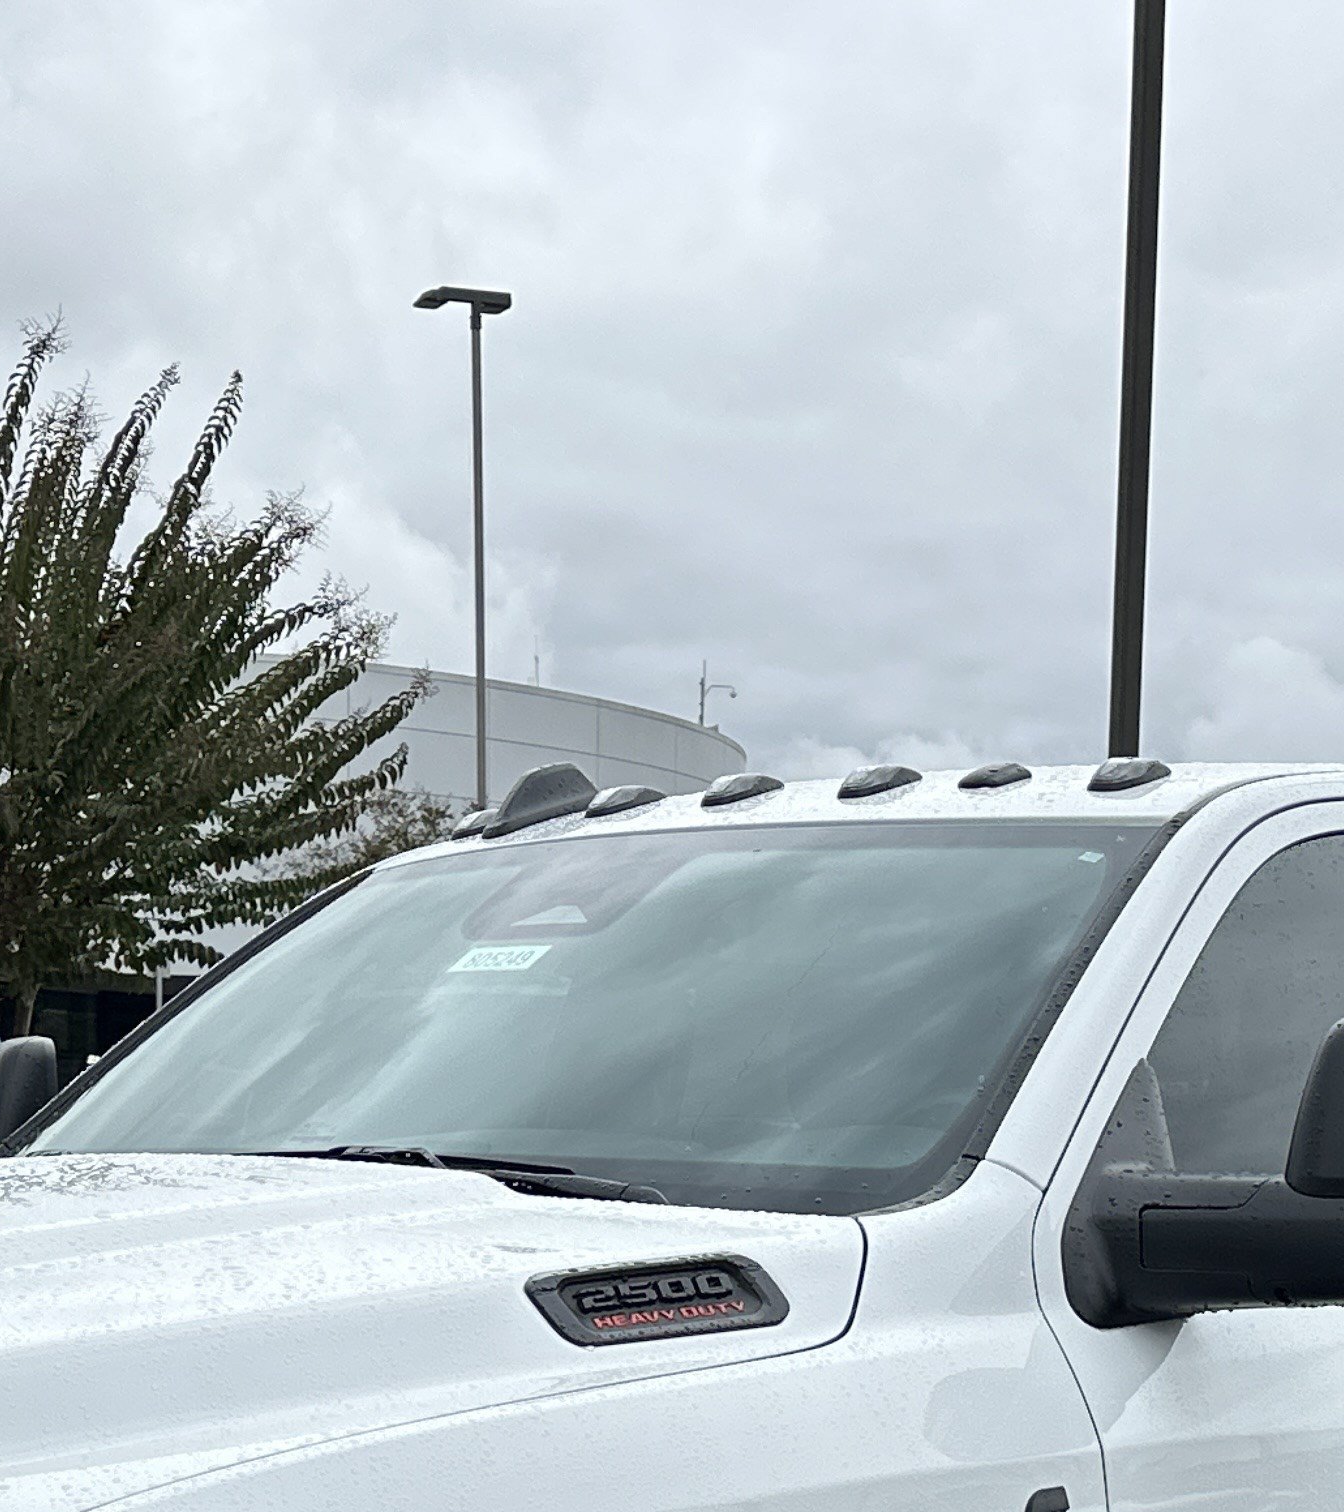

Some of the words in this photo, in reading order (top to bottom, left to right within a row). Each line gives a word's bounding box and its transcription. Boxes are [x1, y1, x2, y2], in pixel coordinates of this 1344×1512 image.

[575, 1273, 733, 1312] 2500
[593, 1309, 676, 1329] HEAVY
[681, 1301, 746, 1319] DUTY
